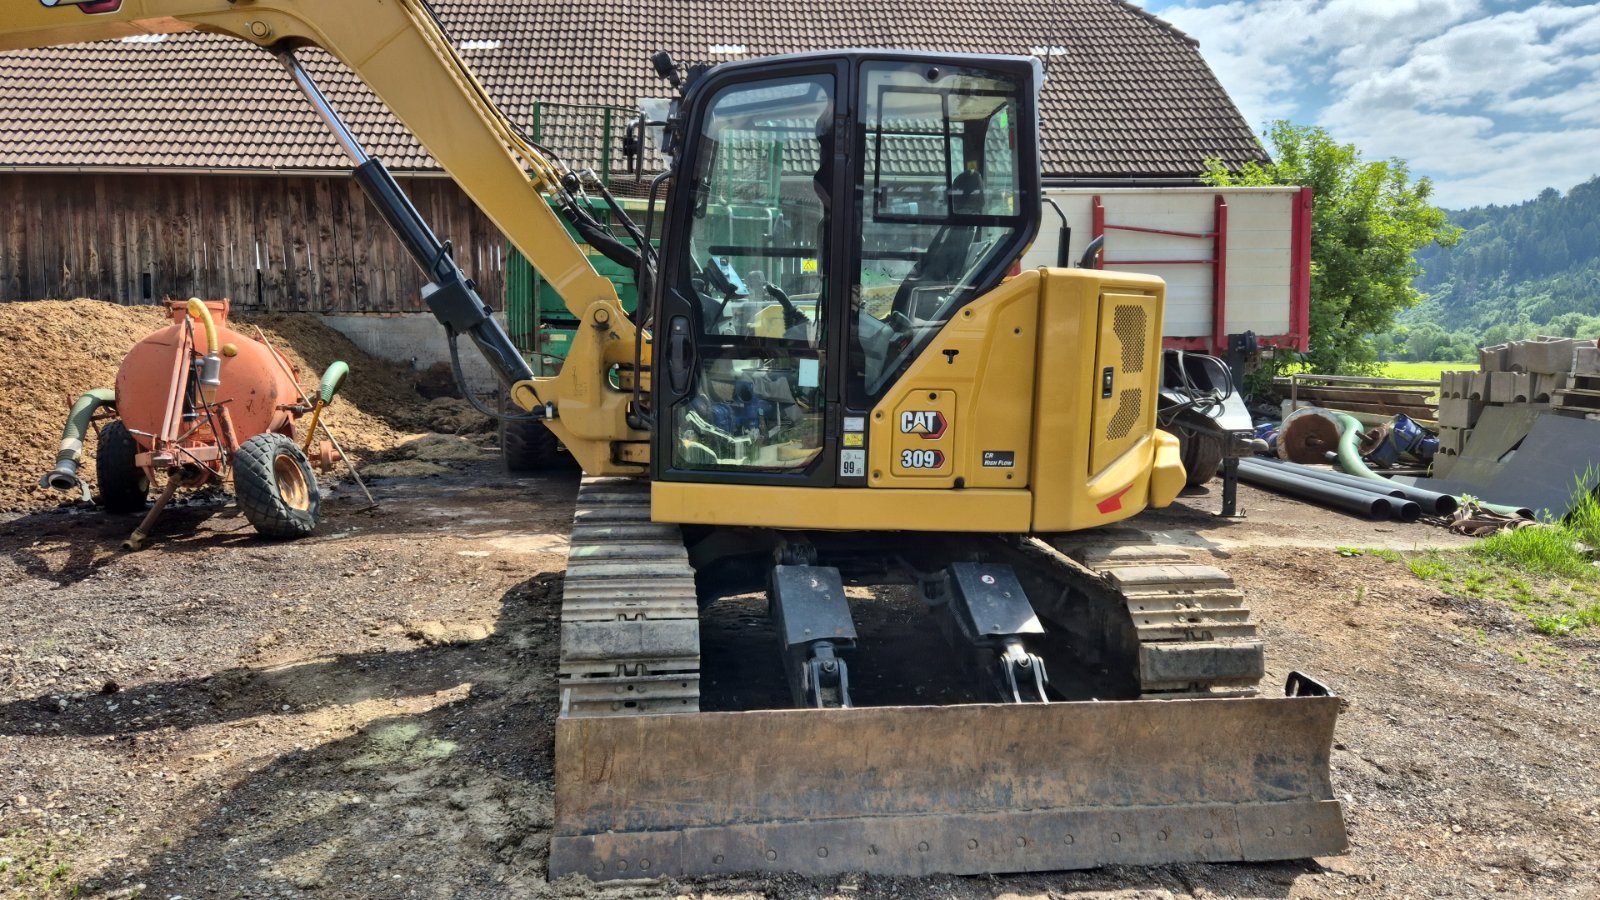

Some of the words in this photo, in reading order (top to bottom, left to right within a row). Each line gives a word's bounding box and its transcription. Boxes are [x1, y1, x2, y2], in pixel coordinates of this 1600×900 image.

[901, 411, 937, 433] CAT
[843, 461, 855, 474] 99
[901, 449, 935, 468] 309
